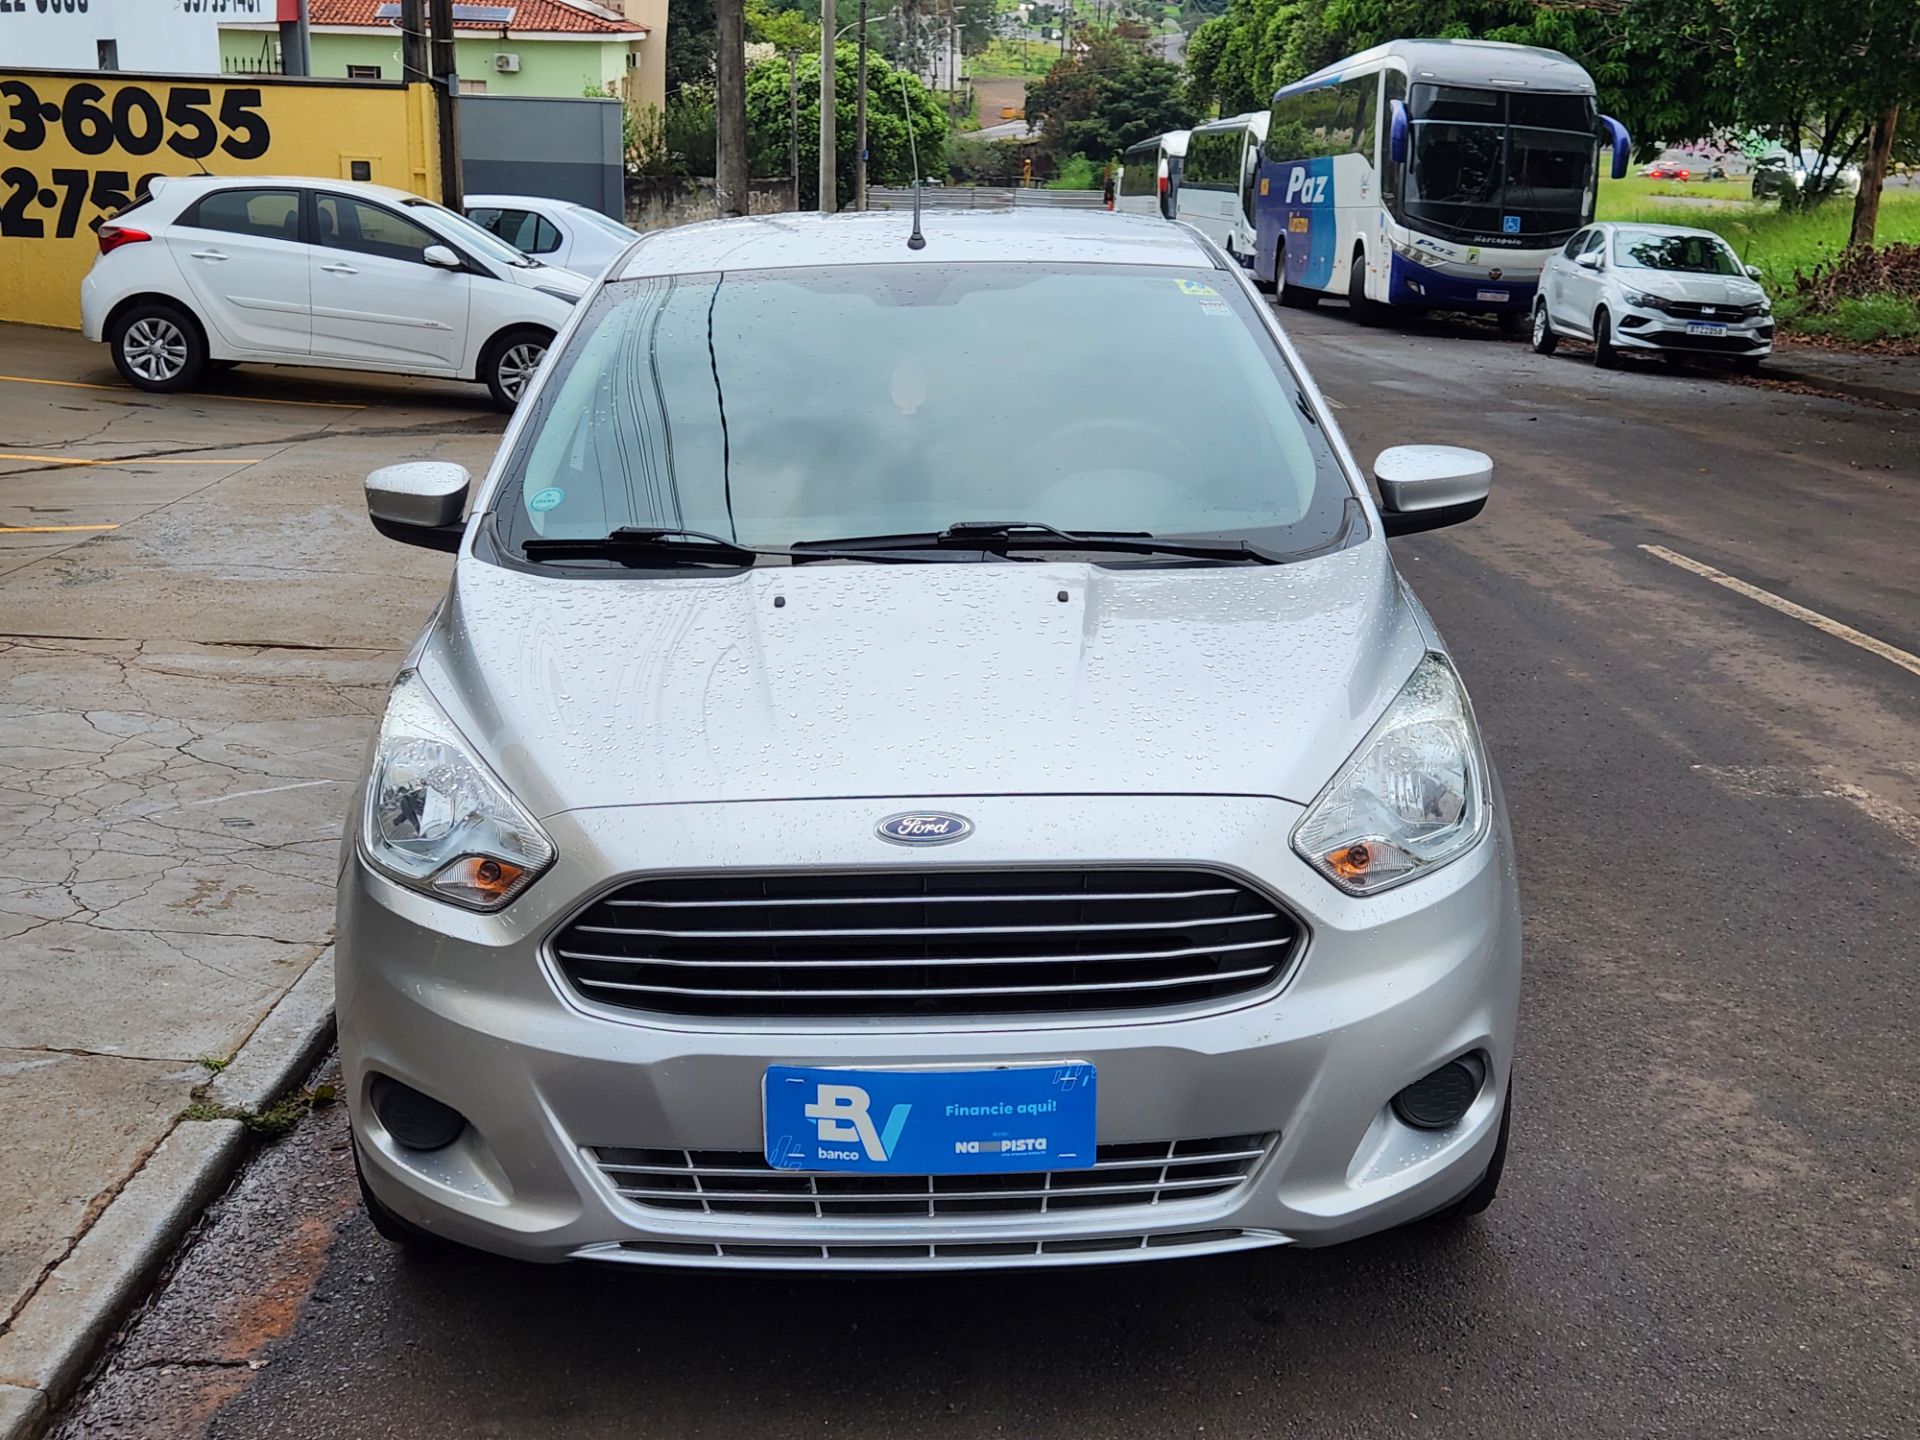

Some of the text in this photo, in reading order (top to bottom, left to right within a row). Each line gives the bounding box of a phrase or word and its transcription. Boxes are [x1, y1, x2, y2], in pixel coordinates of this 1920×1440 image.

[1285, 166, 1328, 204] Paz
[1415, 238, 1457, 257] Paz
[897, 817, 950, 835] Ford
[945, 1101, 1057, 1117] Financie aqui!
[817, 1147, 860, 1161] banco
